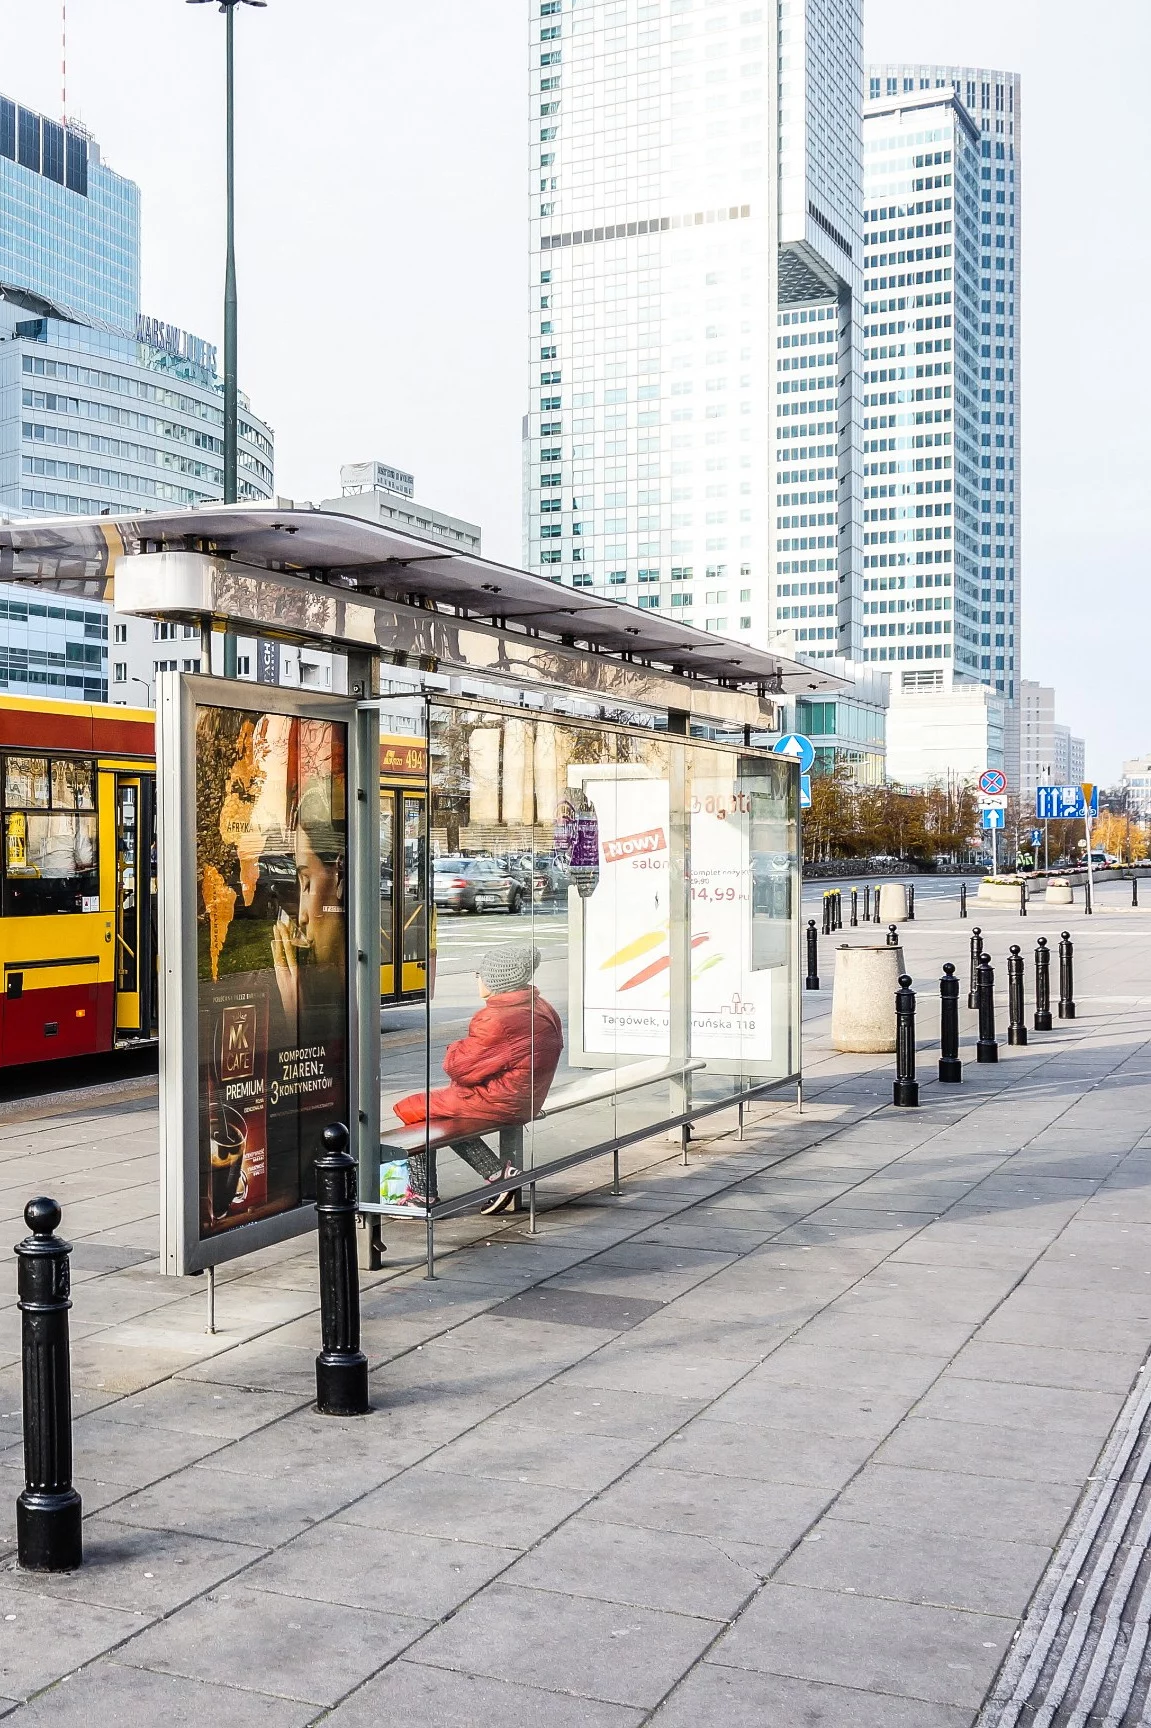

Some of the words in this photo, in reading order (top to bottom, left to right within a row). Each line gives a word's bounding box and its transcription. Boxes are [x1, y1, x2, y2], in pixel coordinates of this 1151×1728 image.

[135, 312, 182, 355] WARSAW
[405, 749, 425, 769] 494
[608, 833, 660, 858] Nowy
[690, 887, 736, 903] 14,99
[601, 1014, 660, 1028] Targówek,
[737, 1020, 756, 1030] 118
[228, 1023, 249, 1051] MK
[278, 1046, 326, 1063] KOMPOZYCJA
[282, 1060, 318, 1081] ZIAREN
[226, 1078, 265, 1101] PREMIUM
[270, 1080, 279, 1105] 3
[279, 1076, 334, 1097] KONTYNENTÓW
